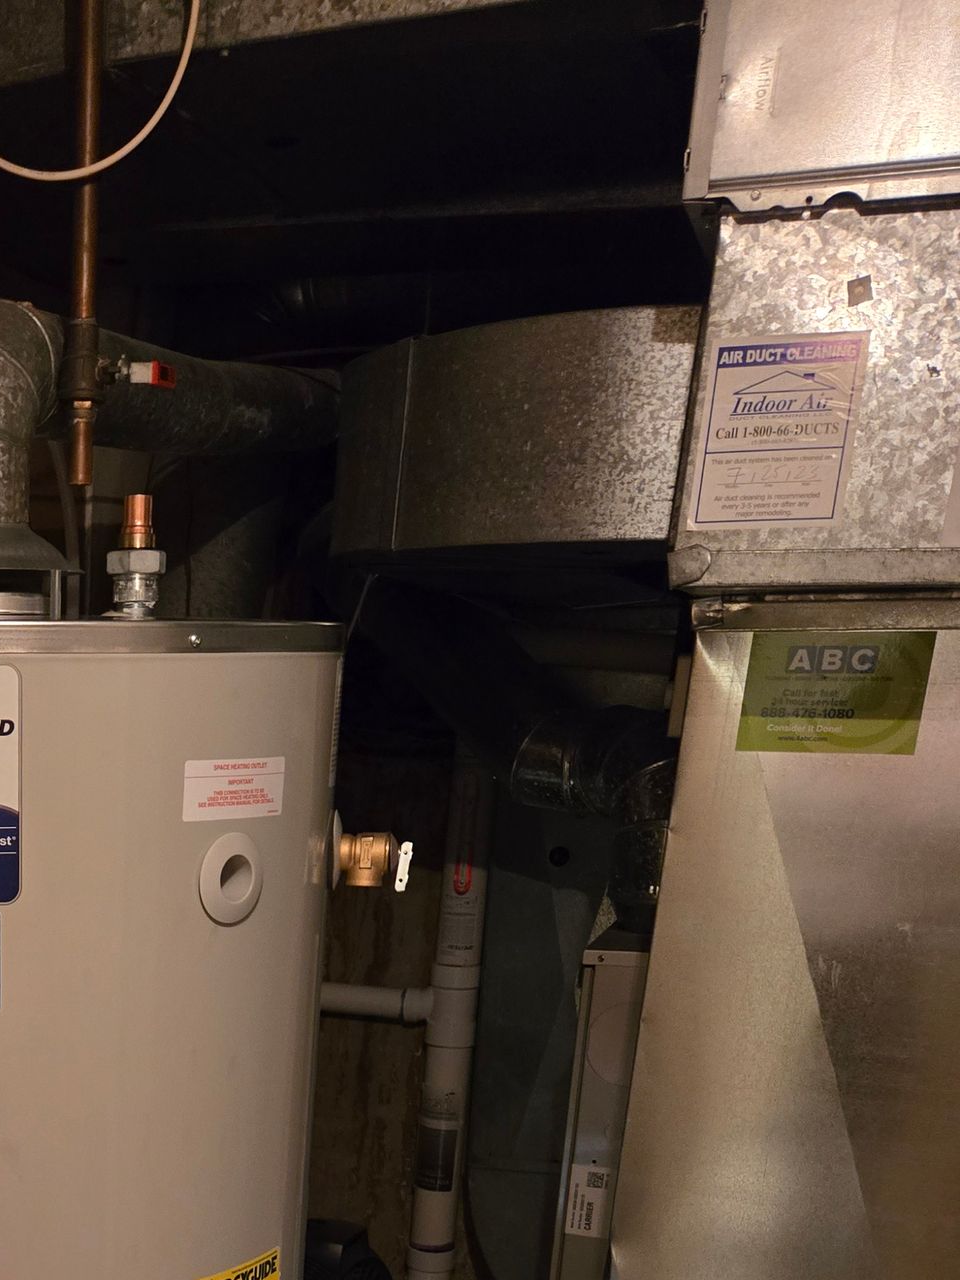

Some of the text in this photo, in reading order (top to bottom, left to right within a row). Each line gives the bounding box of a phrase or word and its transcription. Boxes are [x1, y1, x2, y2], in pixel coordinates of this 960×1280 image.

[755, 56, 774, 110] Airflow
[719, 343, 856, 365] AIR DUCT CLEANING
[732, 392, 833, 414] Indoor Air
[715, 422, 840, 440] Call 1-800-66-DUCTS
[740, 494, 765, 502] cleaning
[788, 648, 875, 671] ABC
[783, 689, 801, 697] Call
[767, 724, 806, 732] Consider
[584, 1201, 594, 1231] CARRIER
